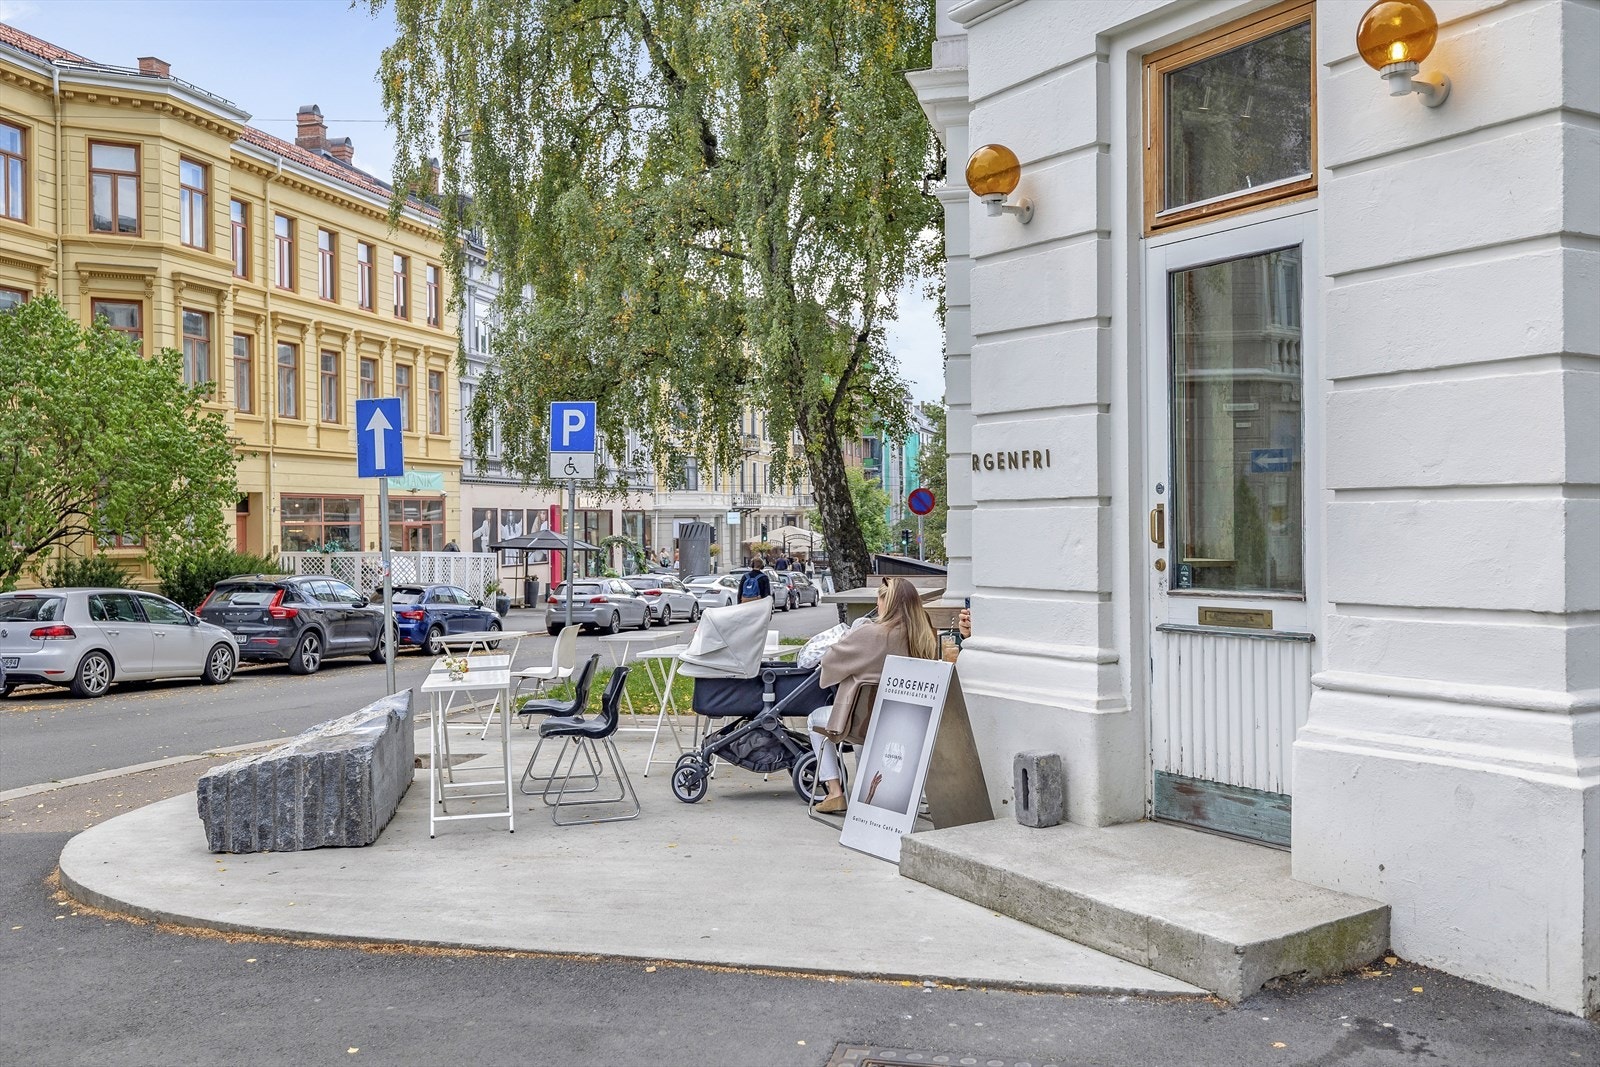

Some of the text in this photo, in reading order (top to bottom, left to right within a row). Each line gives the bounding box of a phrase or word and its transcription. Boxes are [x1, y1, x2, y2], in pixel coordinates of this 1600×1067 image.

[562, 409, 586, 446] P
[971, 448, 1051, 472] RGENFRI
[885, 687, 928, 699] SORGENFRIGATEN
[886, 677, 940, 694] SORGENFRI
[852, 815, 868, 826] Gallery
[869, 820, 881, 828] Store
